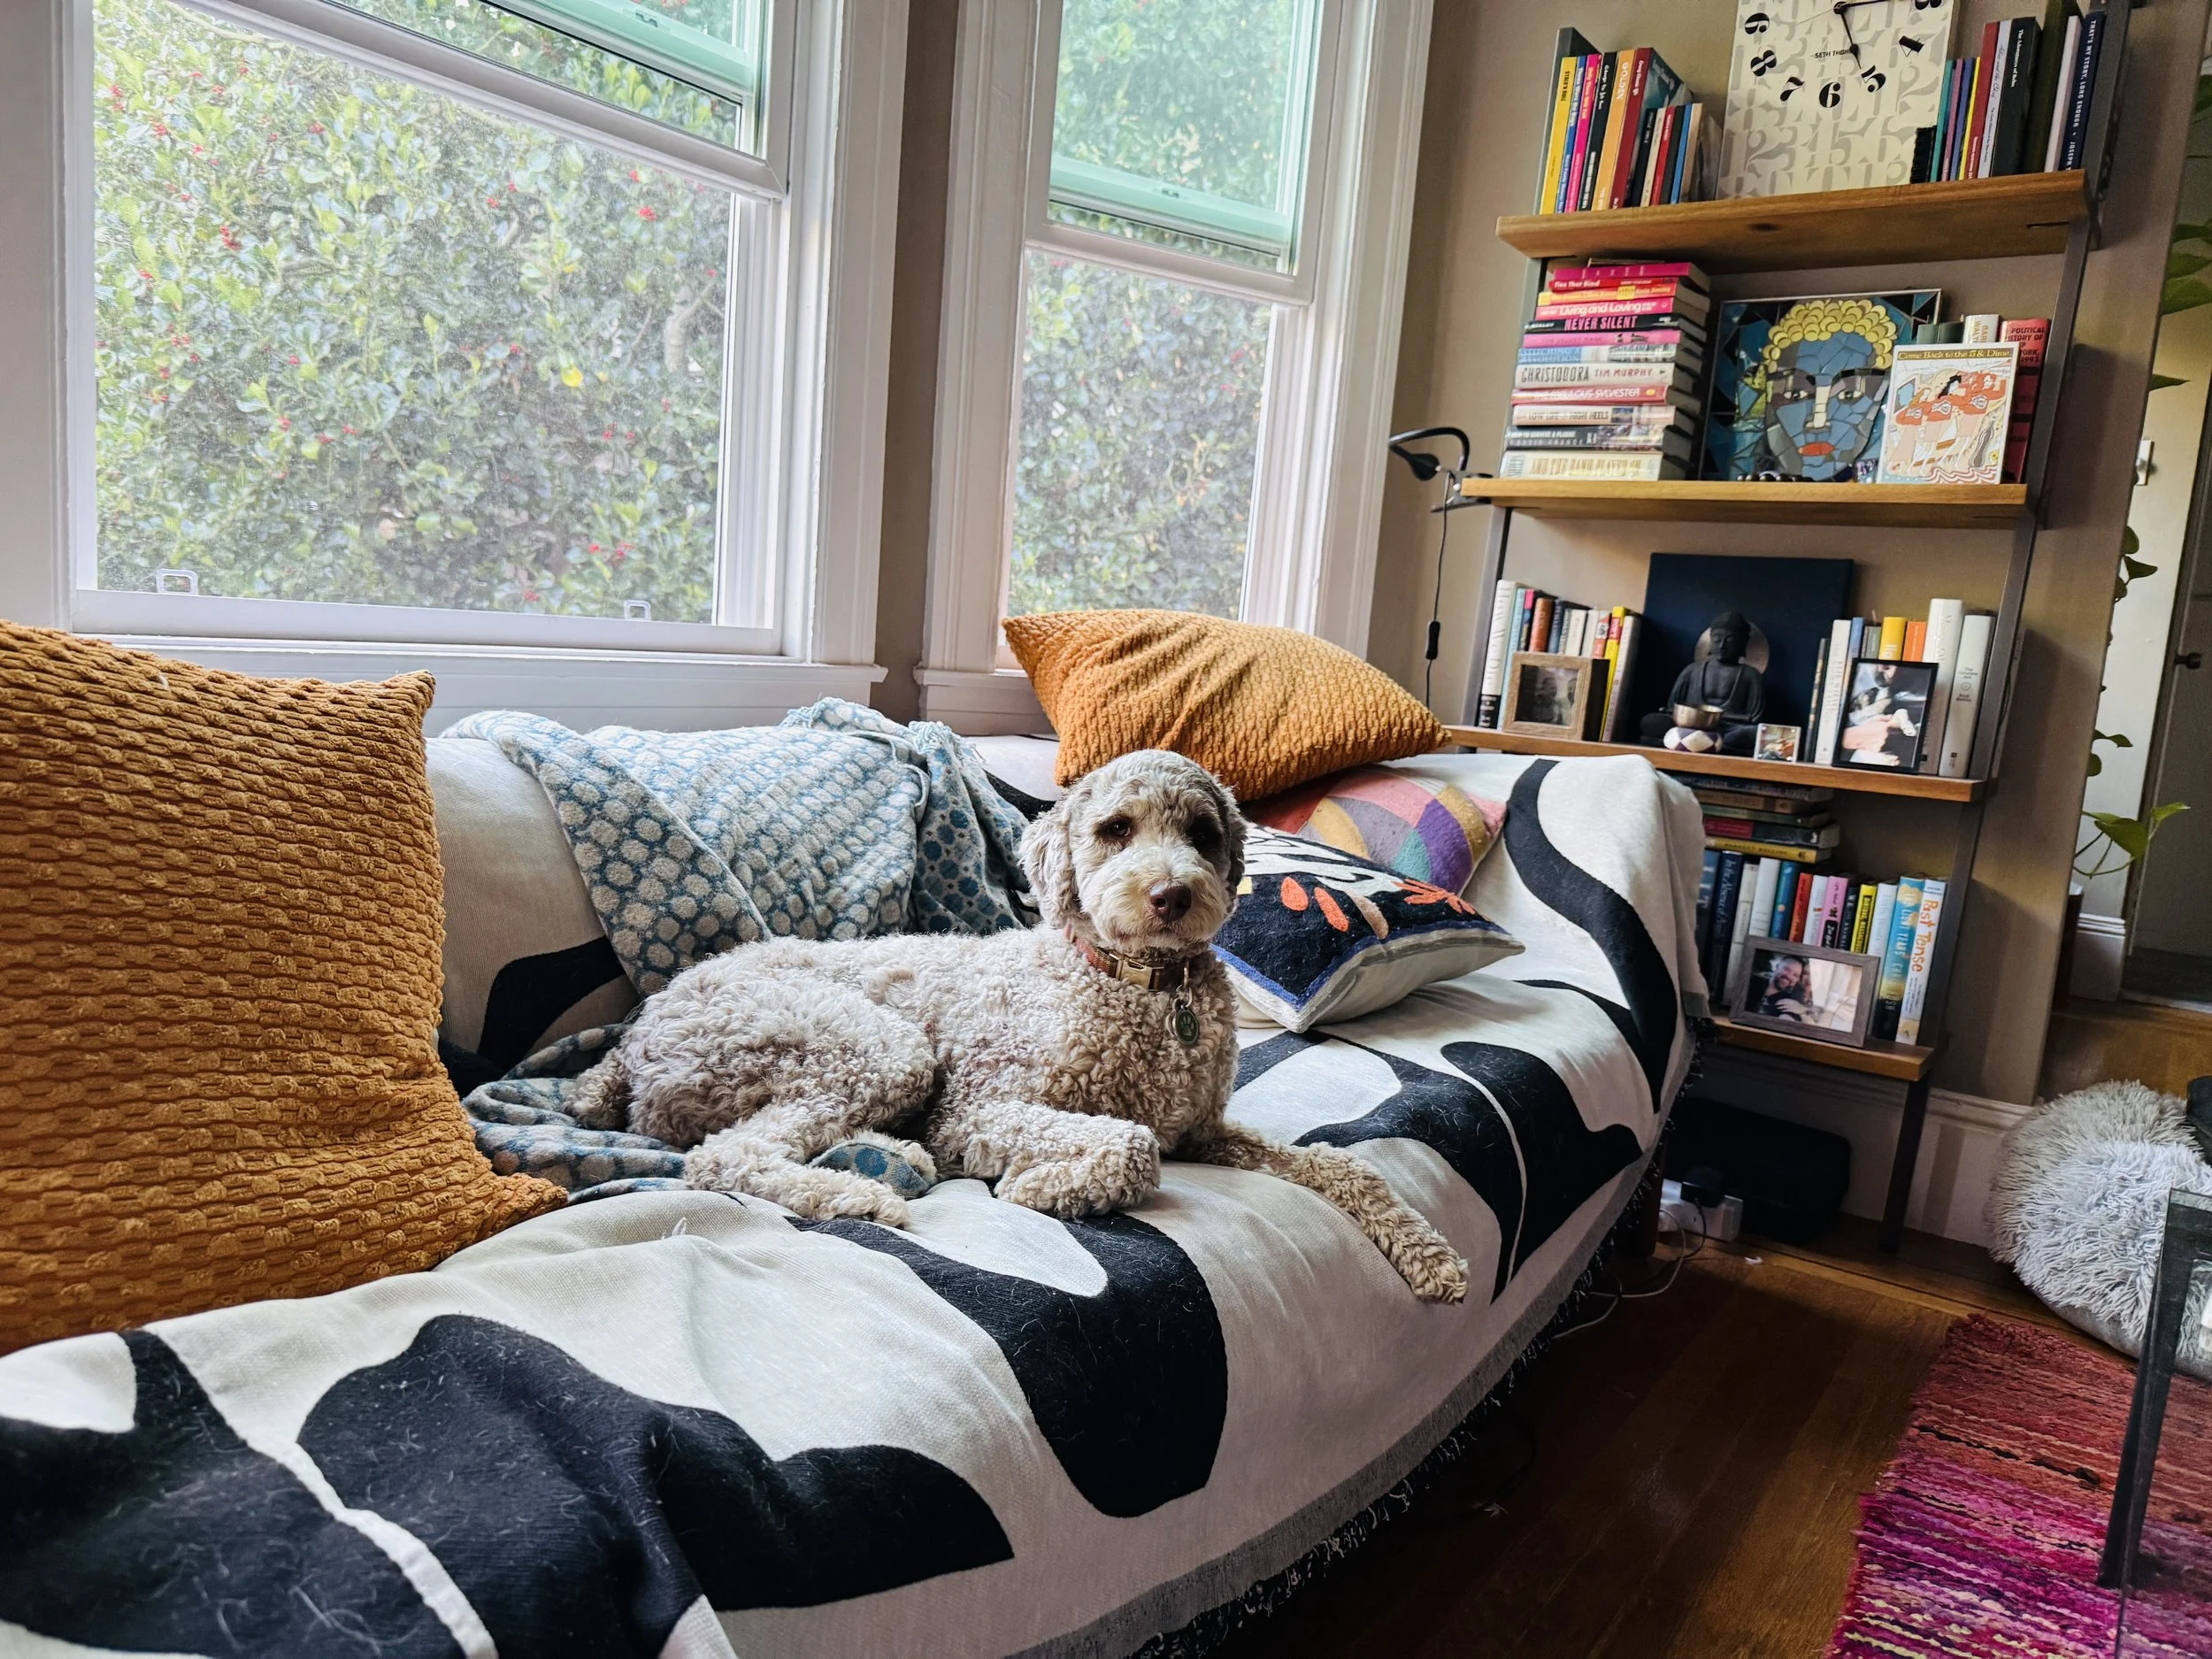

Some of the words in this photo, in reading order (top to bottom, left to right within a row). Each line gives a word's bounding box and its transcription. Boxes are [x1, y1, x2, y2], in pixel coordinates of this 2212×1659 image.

[2087, 19, 2096, 42] THAT'S
[2085, 44, 2092, 55] MY
[1862, 65, 1886, 92] 5
[2081, 56, 2090, 80] STORY,
[1780, 76, 1805, 101] 7
[1819, 82, 1840, 108] 6
[2073, 100, 2082, 127] ENOUGH
[1560, 304, 1588, 317] Living
[1589, 303, 1608, 314] and
[1609, 302, 1642, 314] Loving
[1564, 318, 1598, 330] NEVER
[1600, 316, 1638, 330] SILENT
[1521, 367, 1590, 383] CHRISTODORA
[1614, 368, 1652, 377] MURPHY
[1595, 388, 1640, 399] SYLVESTER
[1918, 899, 1940, 927] Past
[1909, 930, 1933, 973] Tense
